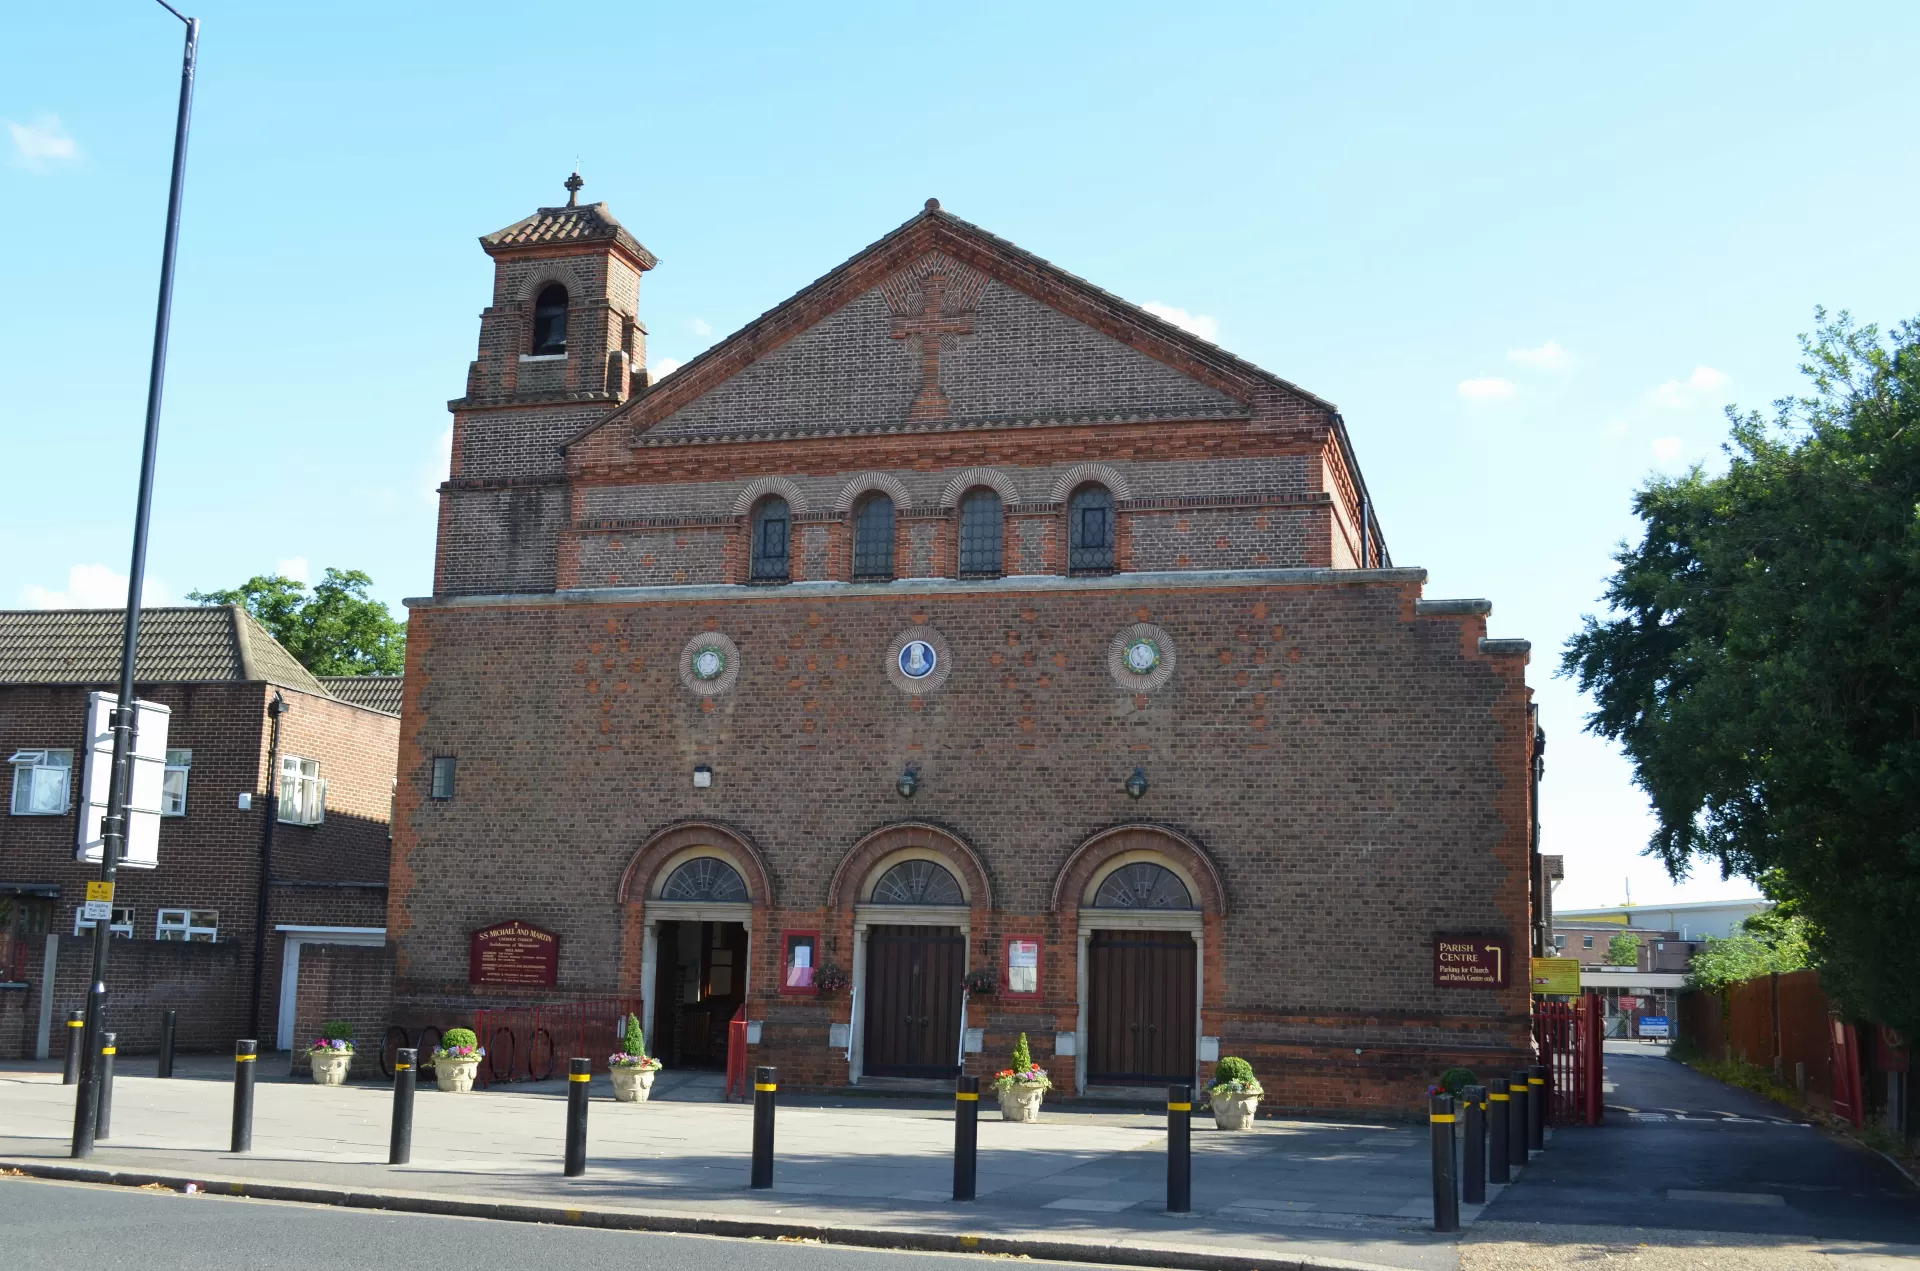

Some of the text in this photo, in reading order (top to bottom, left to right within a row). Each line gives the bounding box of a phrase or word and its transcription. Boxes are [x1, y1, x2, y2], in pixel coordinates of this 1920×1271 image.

[490, 928, 515, 937] MICHAEL
[530, 930, 553, 942] MARTIN
[1440, 942, 1474, 952] PARISH
[1440, 953, 1479, 962] CENTRE
